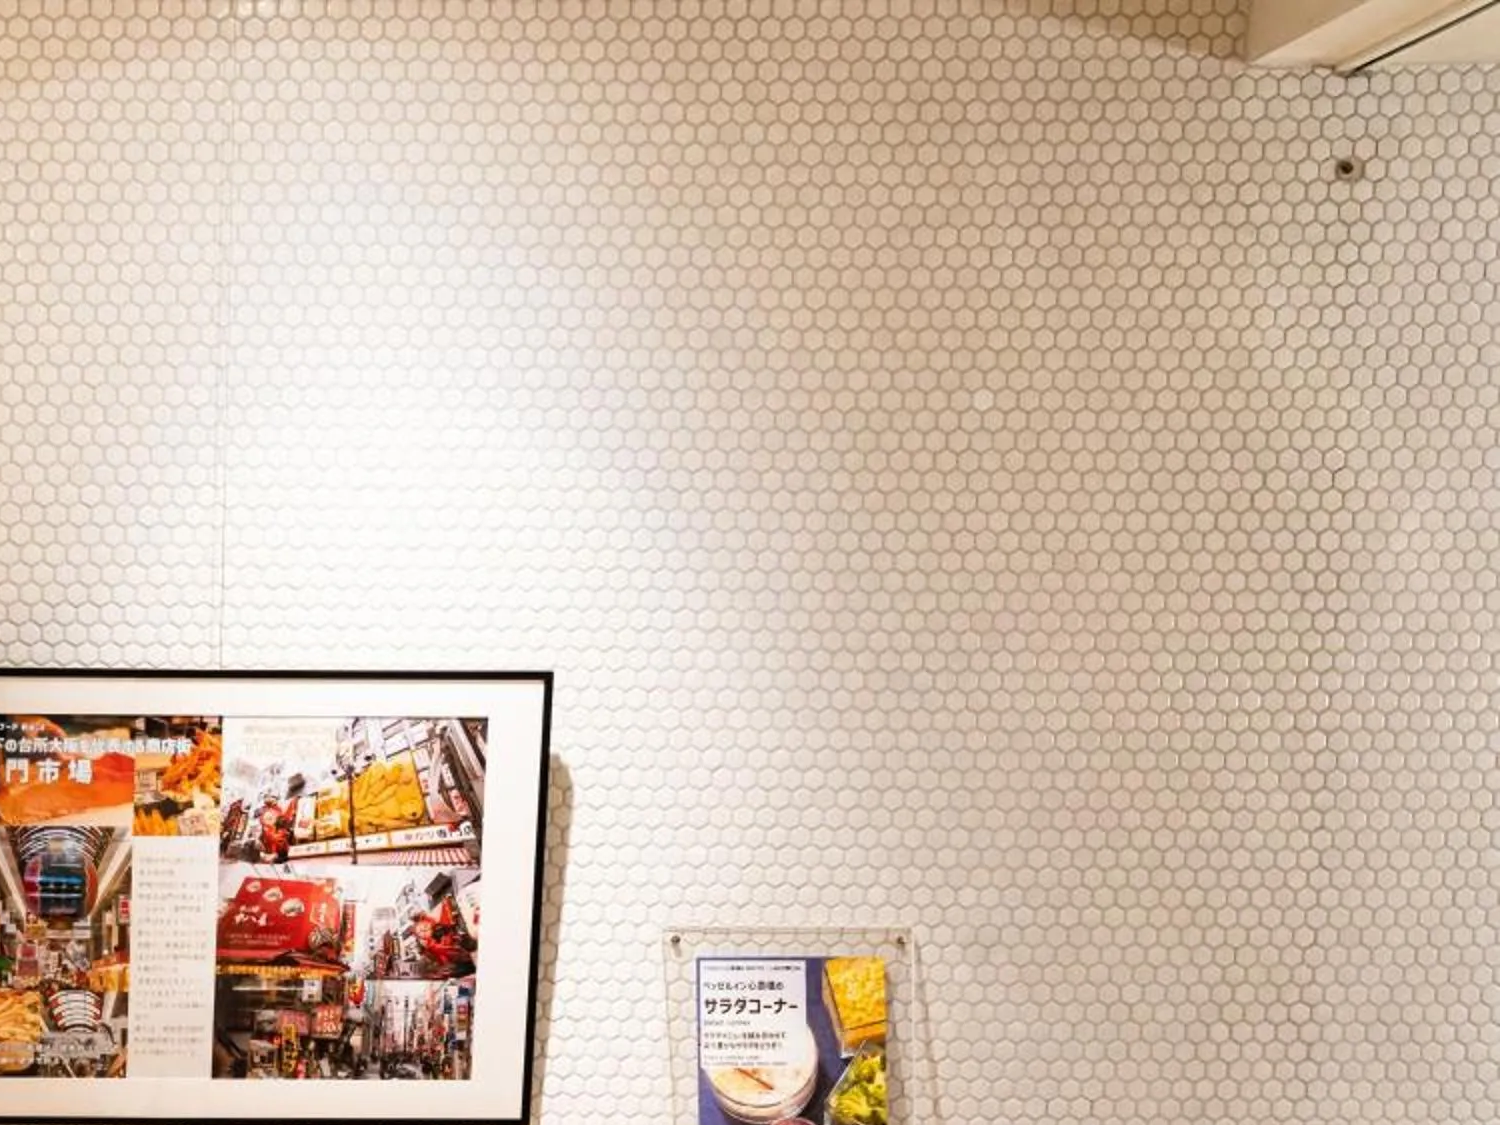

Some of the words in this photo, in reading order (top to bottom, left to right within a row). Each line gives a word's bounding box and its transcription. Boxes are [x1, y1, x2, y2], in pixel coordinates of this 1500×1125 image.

[704, 997, 799, 1015] サラダコーナー
